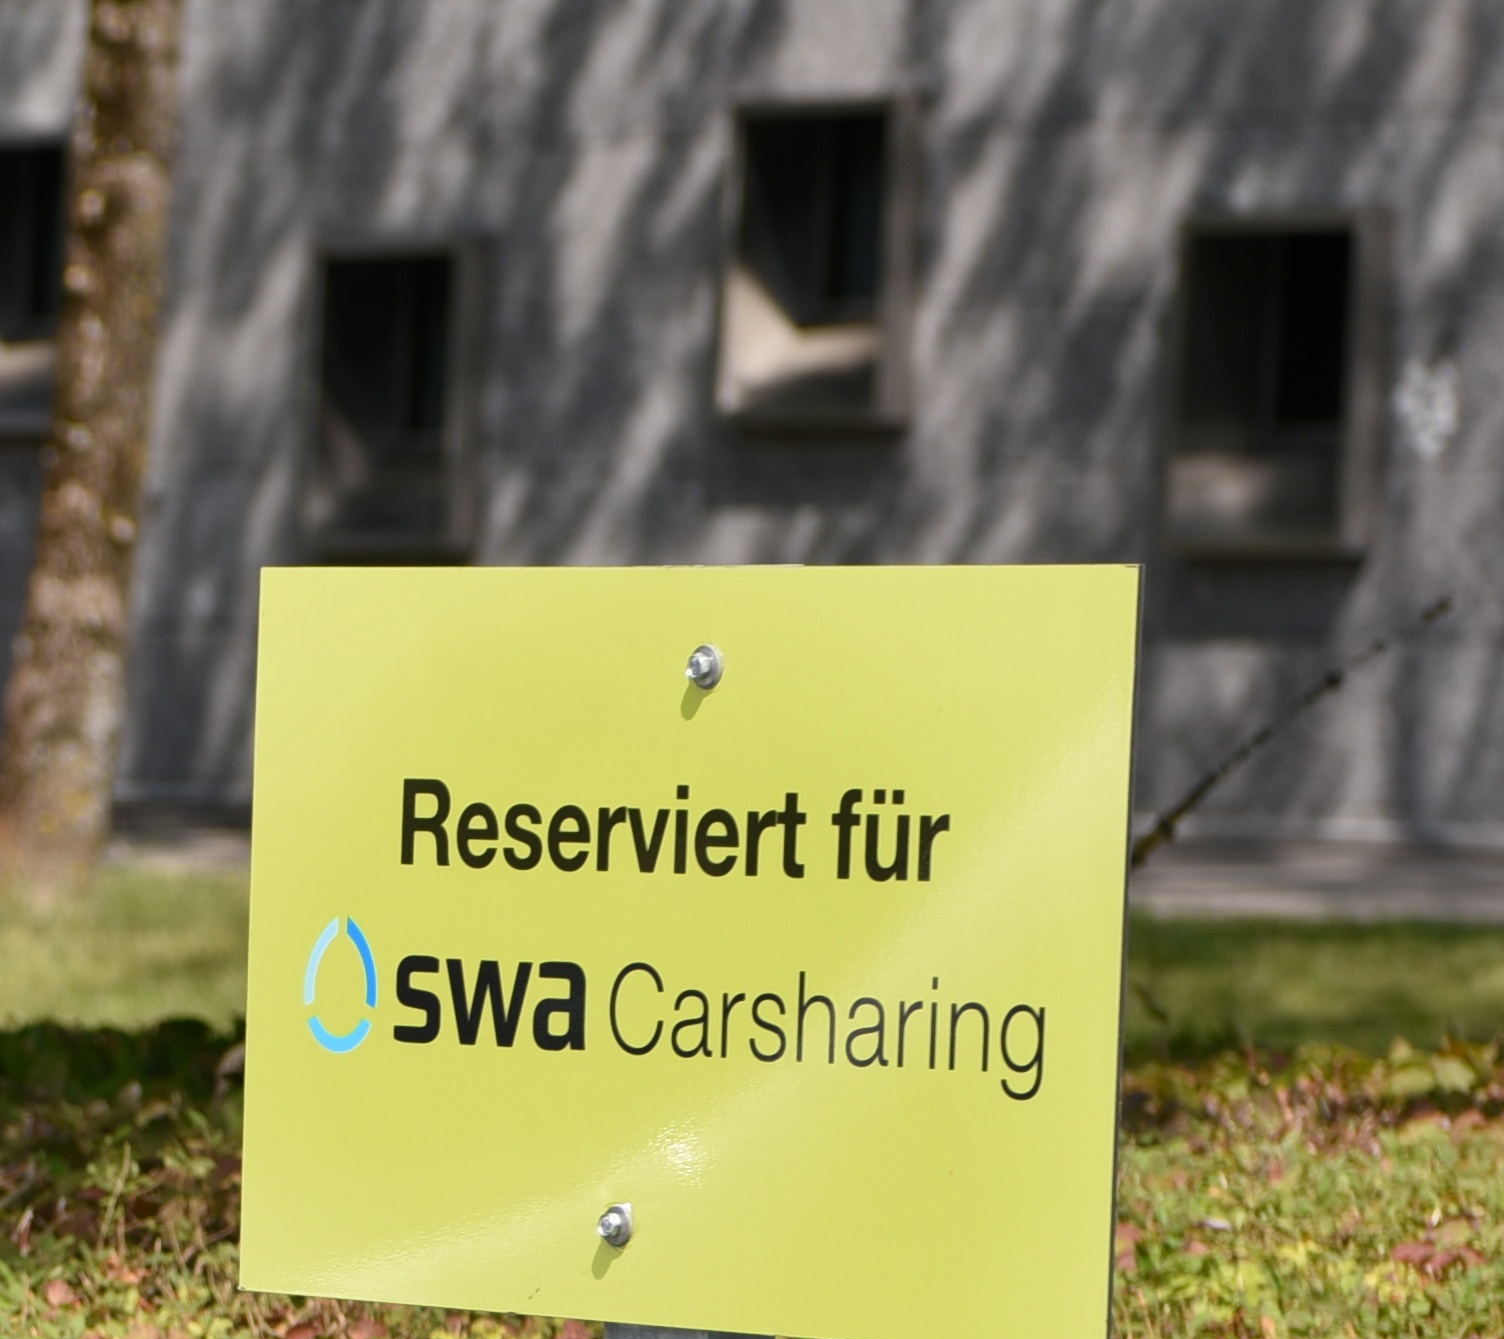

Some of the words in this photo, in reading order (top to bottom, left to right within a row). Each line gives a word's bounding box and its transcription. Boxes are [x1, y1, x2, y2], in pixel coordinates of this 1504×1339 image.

[399, 777, 807, 879] Reserviert
[831, 787, 951, 882] für
[392, 953, 588, 1052] swa
[608, 961, 1048, 1101] Carsharing
